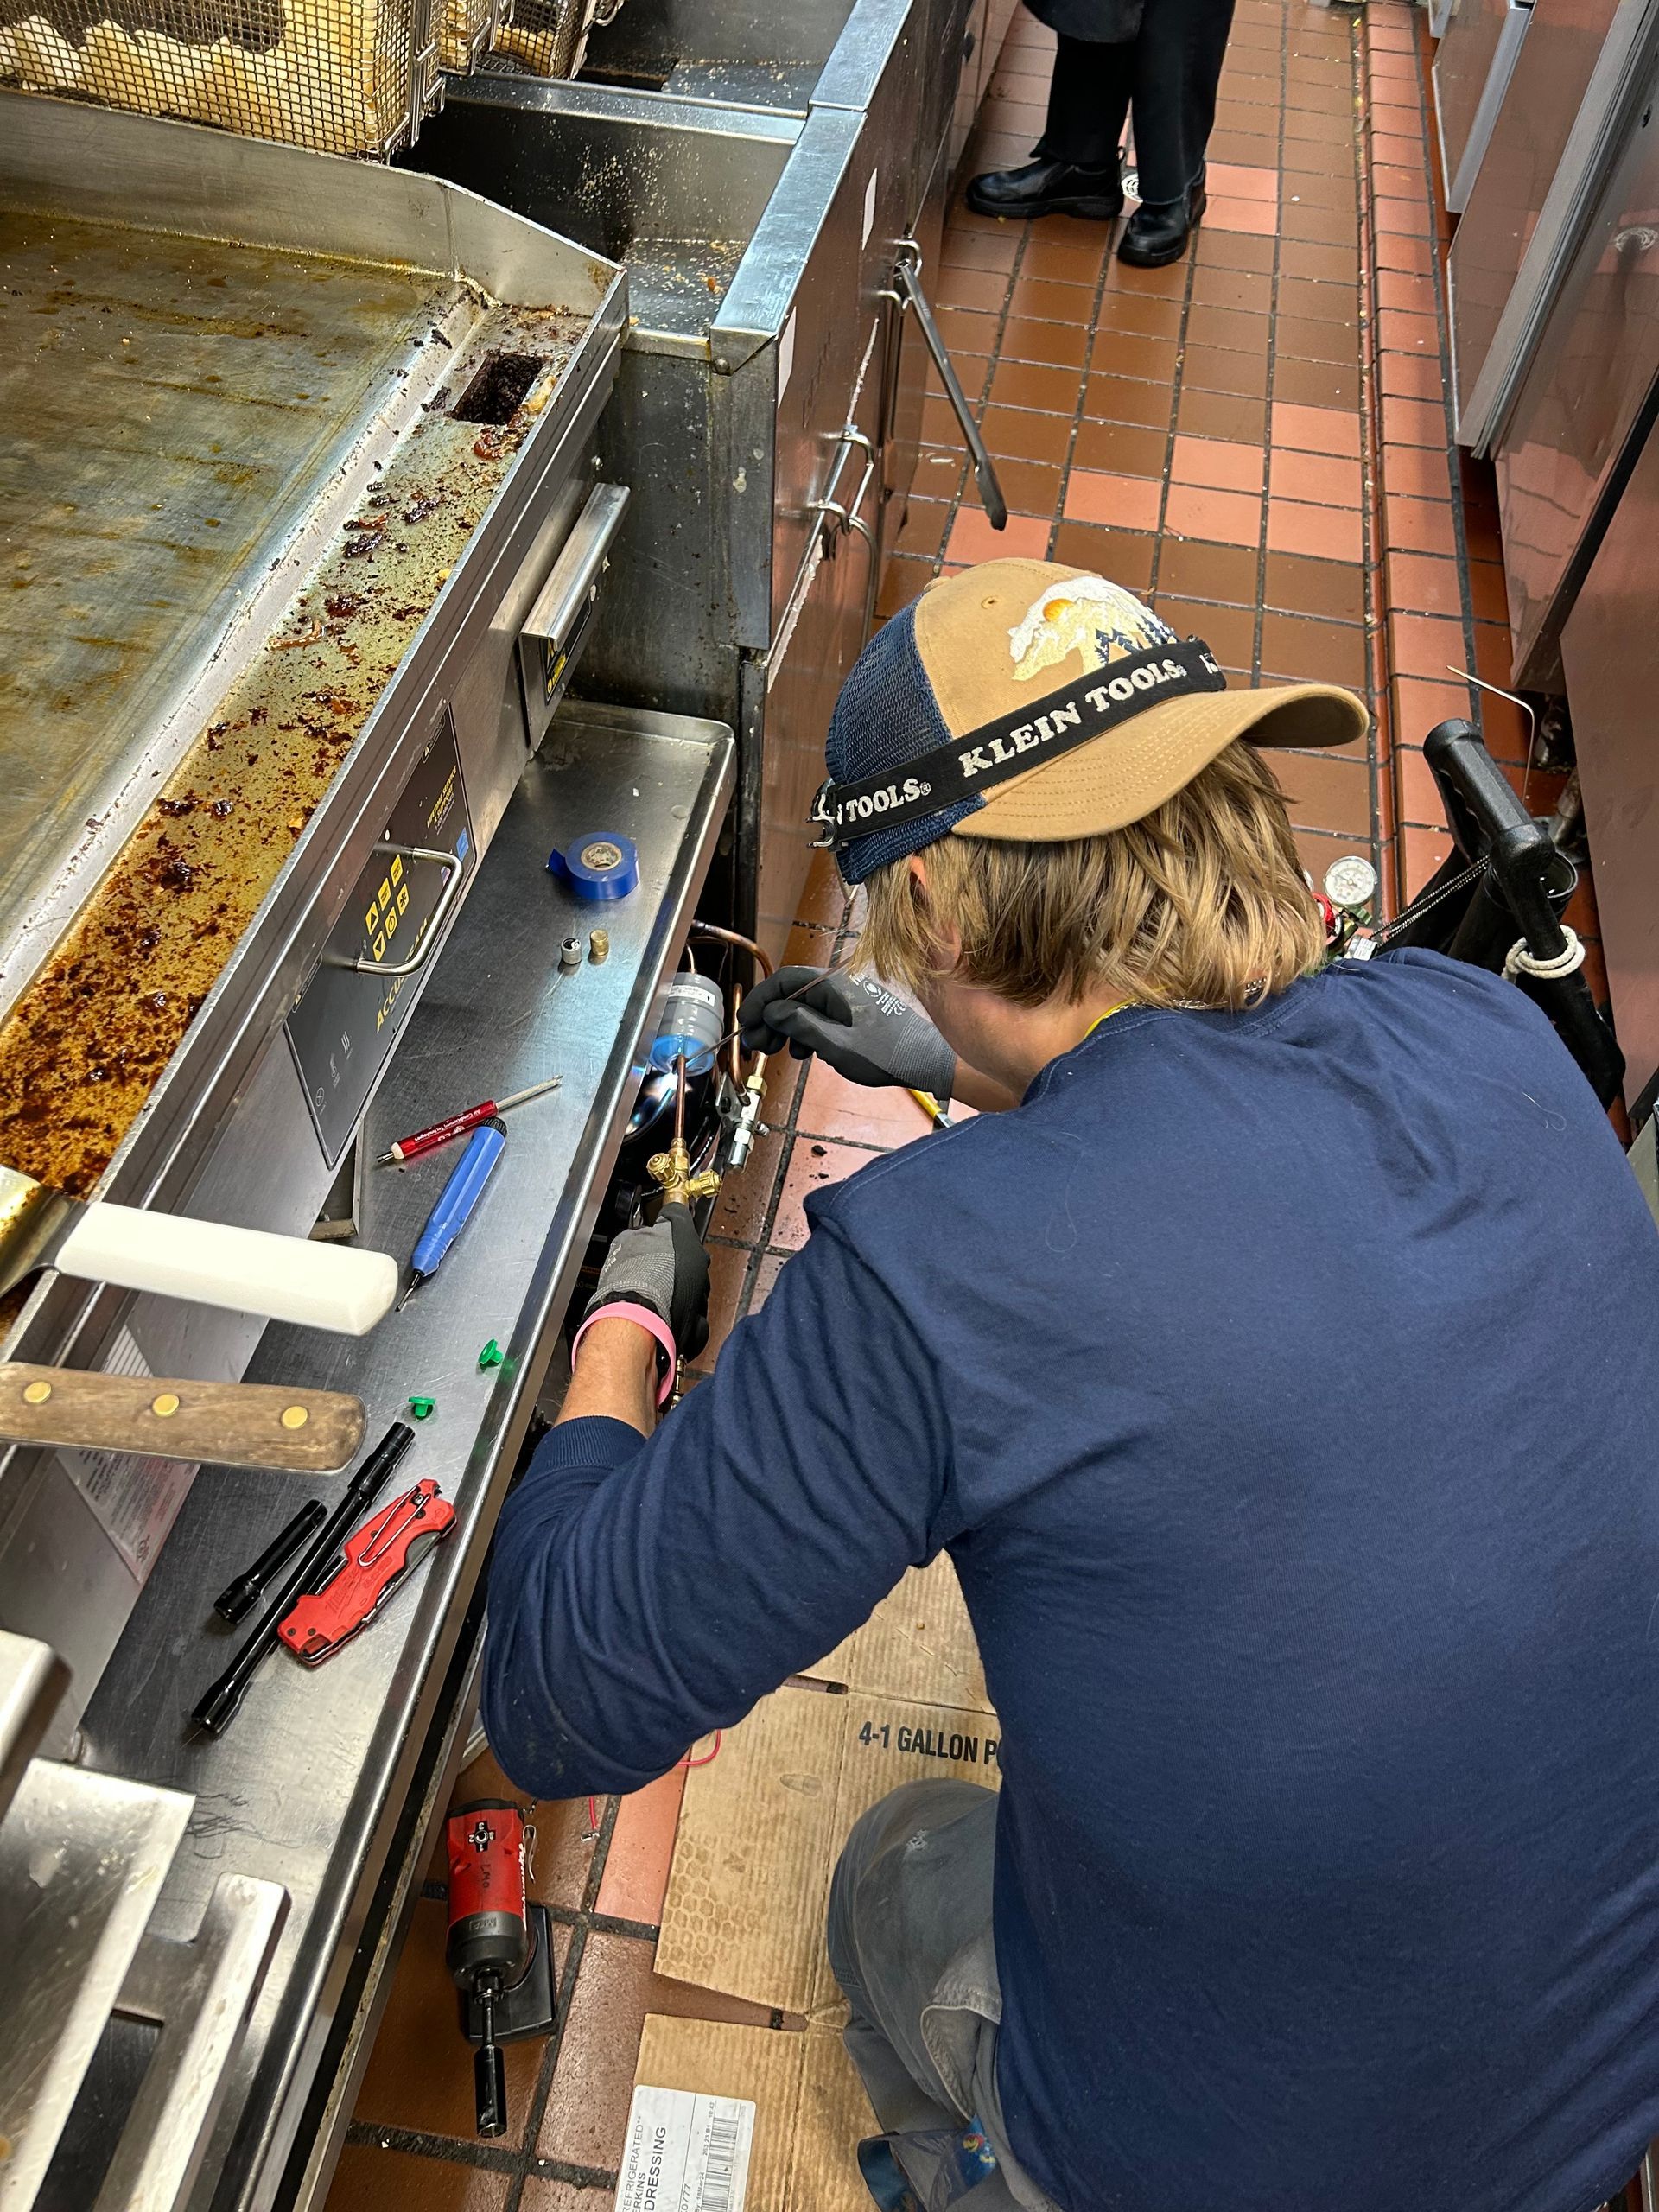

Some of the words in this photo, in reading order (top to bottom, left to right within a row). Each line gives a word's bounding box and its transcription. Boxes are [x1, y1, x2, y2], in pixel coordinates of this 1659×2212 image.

[958, 700, 1082, 778] KLEIN
[859, 1721, 890, 1748] 4-1
[897, 1726, 978, 1763] GALLON
[644, 2126, 666, 2212] DRESSING
